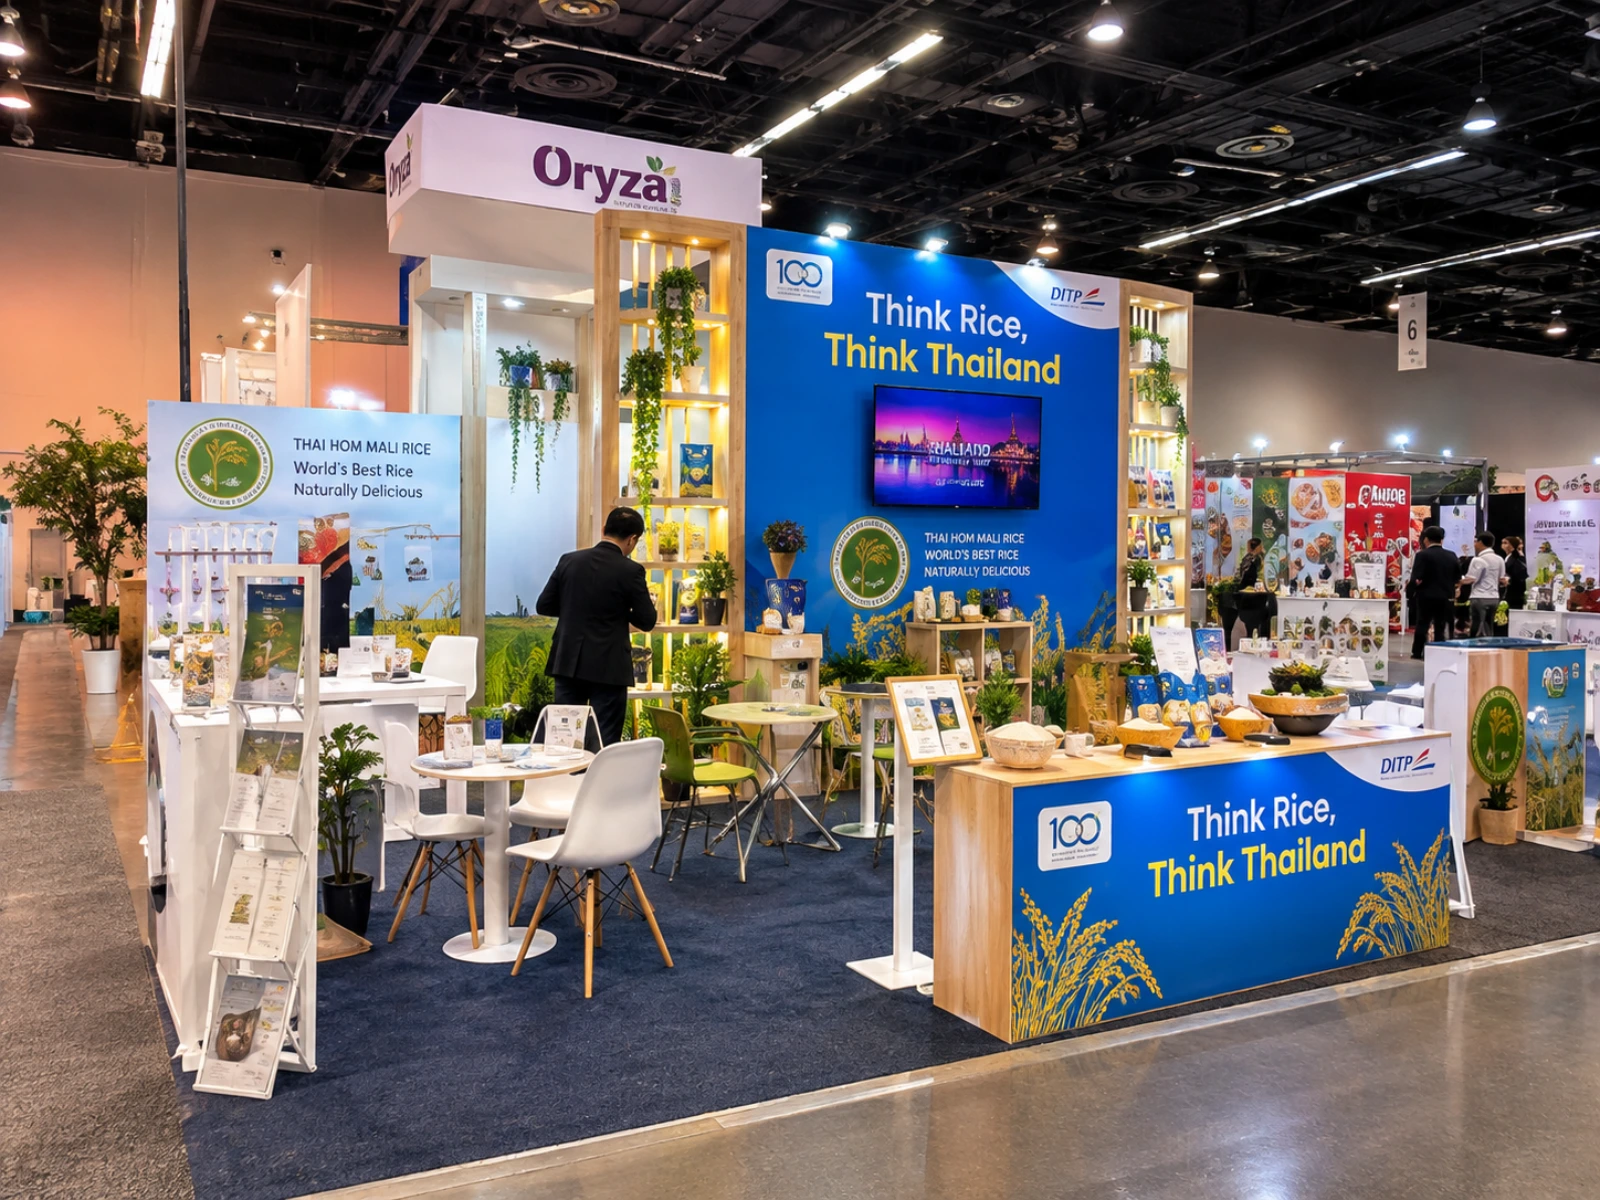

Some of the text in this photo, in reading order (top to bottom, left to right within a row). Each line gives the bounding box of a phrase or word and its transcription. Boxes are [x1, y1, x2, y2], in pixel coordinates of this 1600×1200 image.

[533, 145, 667, 204] Oryza
[776, 258, 823, 288] 100
[1050, 286, 1083, 303] DITP
[865, 291, 1028, 345] Think Rice,
[1407, 319, 1418, 341] 6
[824, 332, 1061, 385] Think Thailand
[293, 438, 431, 456] THAI HOM MALI RICE
[293, 460, 414, 478] World's Best Rice
[294, 482, 423, 501] Naturally Delicious
[924, 532, 1025, 544] THAI HOM MALI RICE
[924, 549, 1019, 561] WORLD'S BEST RICE
[924, 565, 1031, 578] NATURALLY DELICIOUS
[1380, 755, 1413, 775] DITP
[1187, 792, 1336, 842] Think Rice,
[1049, 812, 1101, 850] 100
[1148, 828, 1366, 898] Think Thailand
